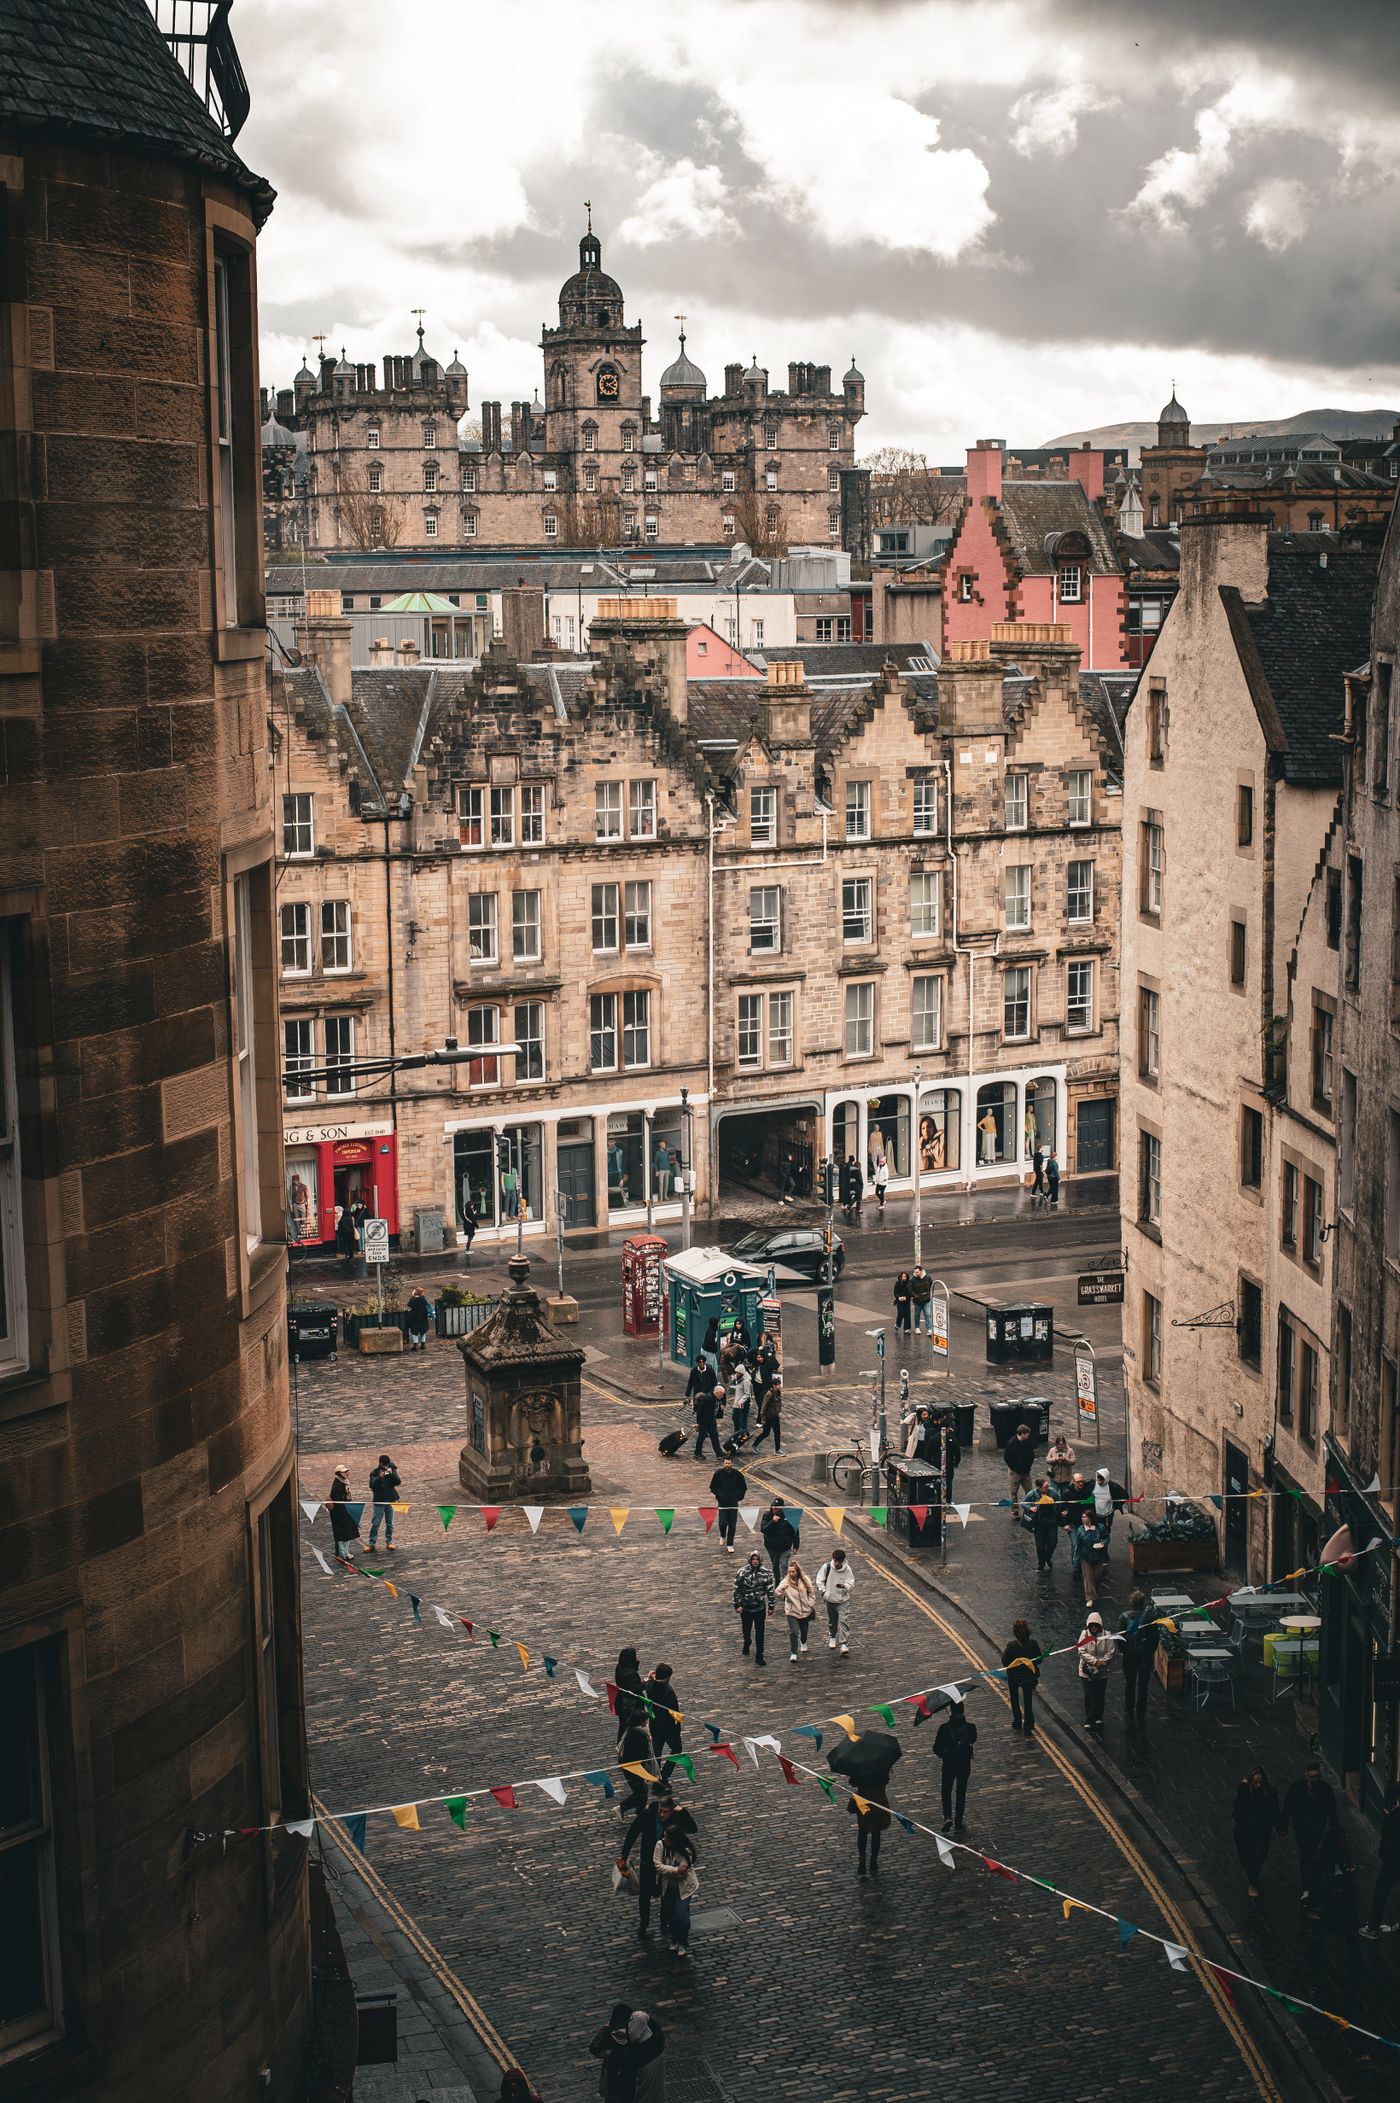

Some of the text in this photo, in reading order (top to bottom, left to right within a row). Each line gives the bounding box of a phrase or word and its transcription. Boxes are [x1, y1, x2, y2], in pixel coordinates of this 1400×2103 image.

[306, 1129, 315, 1141] &
[320, 1126, 348, 1140] SON
[1081, 1284, 1122, 1295] GRASSMARKET
